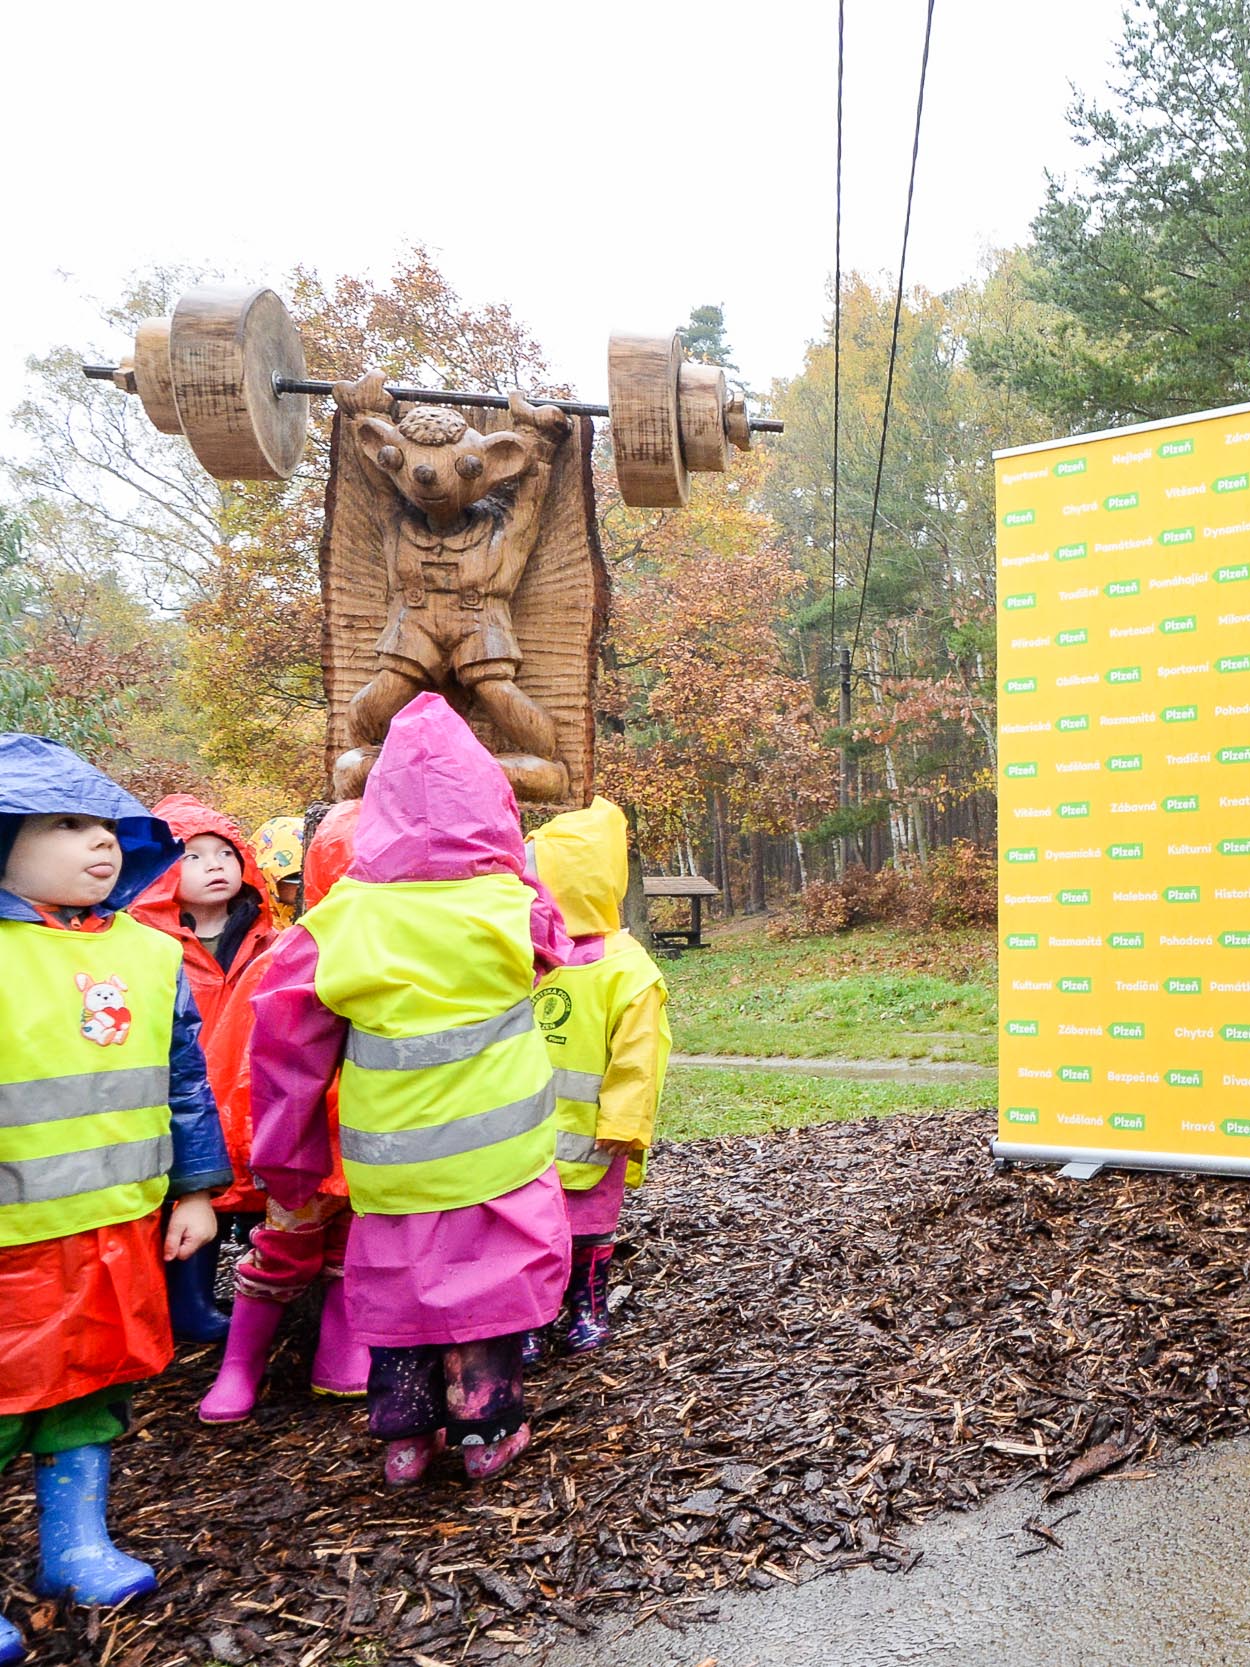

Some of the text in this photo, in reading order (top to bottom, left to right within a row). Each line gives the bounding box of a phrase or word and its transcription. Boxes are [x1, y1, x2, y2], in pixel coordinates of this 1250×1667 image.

[1162, 441, 1191, 455] Plzeň
[1057, 460, 1084, 474] Plzeň
[1217, 476, 1246, 491] Plzeň
[1108, 495, 1136, 508] Plzeň
[1006, 512, 1033, 524] Plzeň
[1163, 529, 1192, 543] Plzeň
[1058, 545, 1084, 559] Plzeň
[1219, 566, 1248, 581] Plzeň
[1109, 582, 1138, 595] Plzeň
[1007, 595, 1033, 608] Plzeň
[1164, 618, 1194, 632] Plzeň
[1059, 631, 1085, 644] Plzeň
[1220, 657, 1250, 671] Plzeň
[1110, 669, 1139, 682] Plzeň
[1008, 680, 1035, 691] Plzeň
[1165, 708, 1195, 720] Plzeň
[1060, 717, 1086, 729] Plzeň
[1221, 749, 1250, 761] Plzeň
[1111, 757, 1140, 768] Plzeň
[1008, 764, 1035, 776] Plzeň
[1060, 804, 1087, 816] Plzeň
[1167, 798, 1196, 810] Plzeň
[1008, 850, 1036, 861] Plzeň
[1112, 846, 1140, 857] Plzeň
[1061, 892, 1088, 902] Plzeň
[1168, 889, 1197, 900] Plzeň
[1008, 937, 1036, 947] Plzeň
[1113, 935, 1141, 946] Plzeň
[1061, 980, 1089, 991] Plzeň
[1169, 981, 1199, 991] Plzeň
[1009, 1024, 1036, 1033] Plzeň
[1113, 1025, 1142, 1036] Plzeň
[1062, 1069, 1089, 1080] Plzeň
[1170, 1073, 1199, 1084] Plzeň
[1009, 1110, 1036, 1122] Plzeň
[1114, 1116, 1142, 1128] Plzeň
